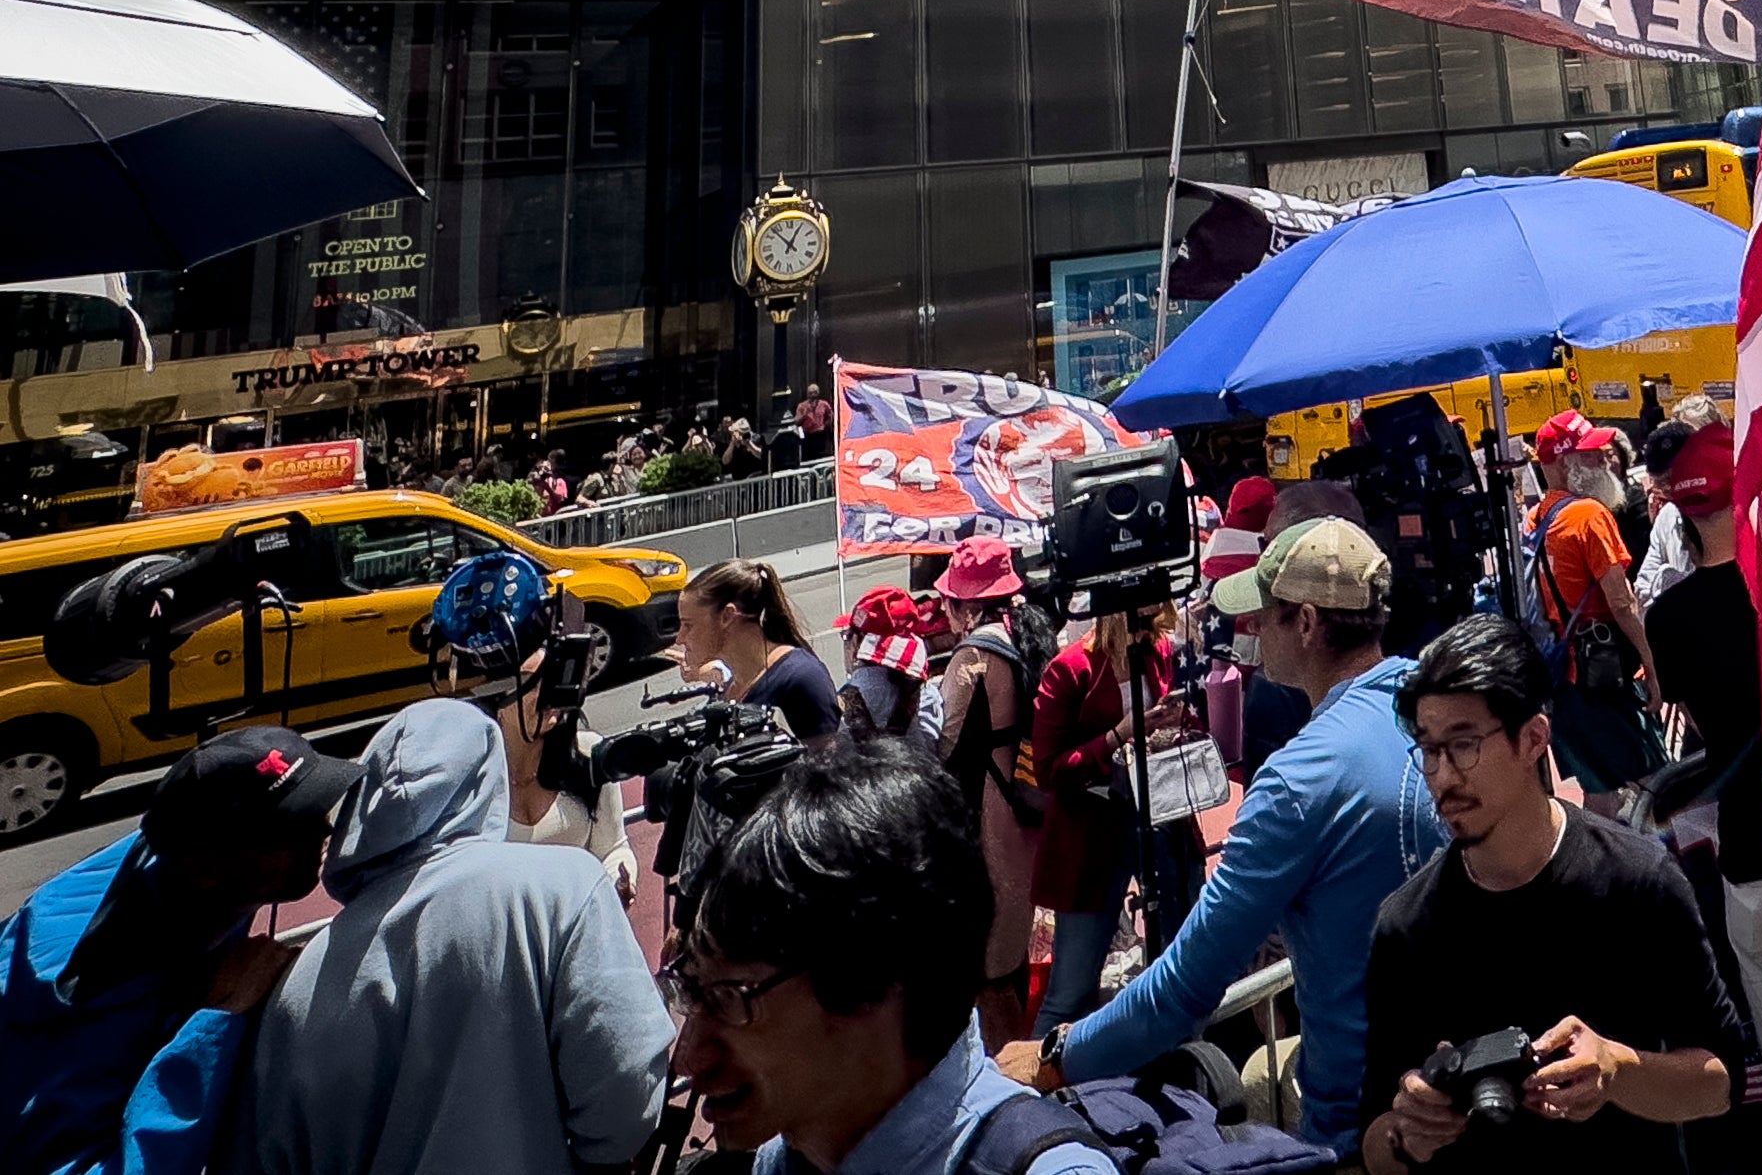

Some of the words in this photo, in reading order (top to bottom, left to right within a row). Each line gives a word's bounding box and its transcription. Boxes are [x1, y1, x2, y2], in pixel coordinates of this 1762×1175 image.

[1303, 178, 1396, 203] GUCCI
[325, 238, 381, 256] OPEN
[384, 235, 412, 250] TO
[308, 260, 351, 278] THE
[354, 253, 427, 273] PUBLIC
[232, 358, 356, 393] TRUMP
[362, 344, 481, 376] TOWER
[30, 464, 55, 478] 725
[862, 513, 960, 544] FOR
